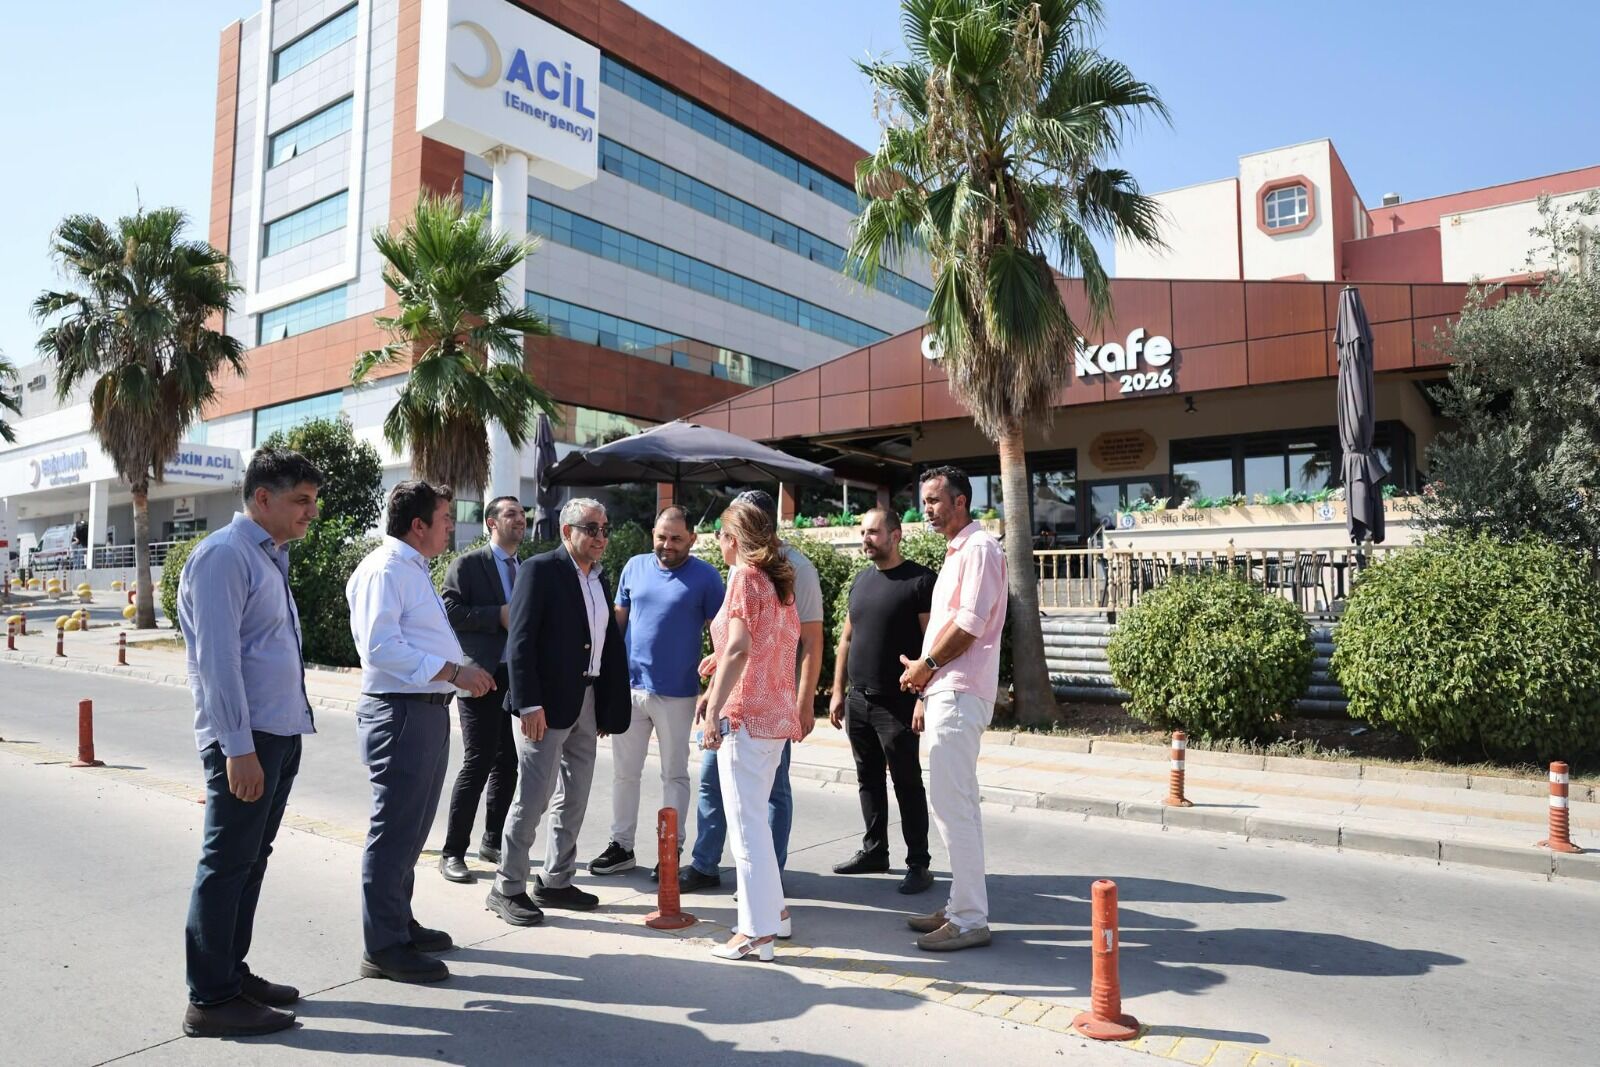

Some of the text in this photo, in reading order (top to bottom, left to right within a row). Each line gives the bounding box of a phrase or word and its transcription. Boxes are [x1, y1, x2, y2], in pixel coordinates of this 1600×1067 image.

[505, 48, 595, 120] ACİL
[504, 91, 593, 143] (Emergency)
[1075, 327, 1174, 377] kafe
[1120, 368, 1173, 394] 2026
[174, 451, 234, 469] ŞKİN ACİL
[1182, 512, 1204, 522] kafe
